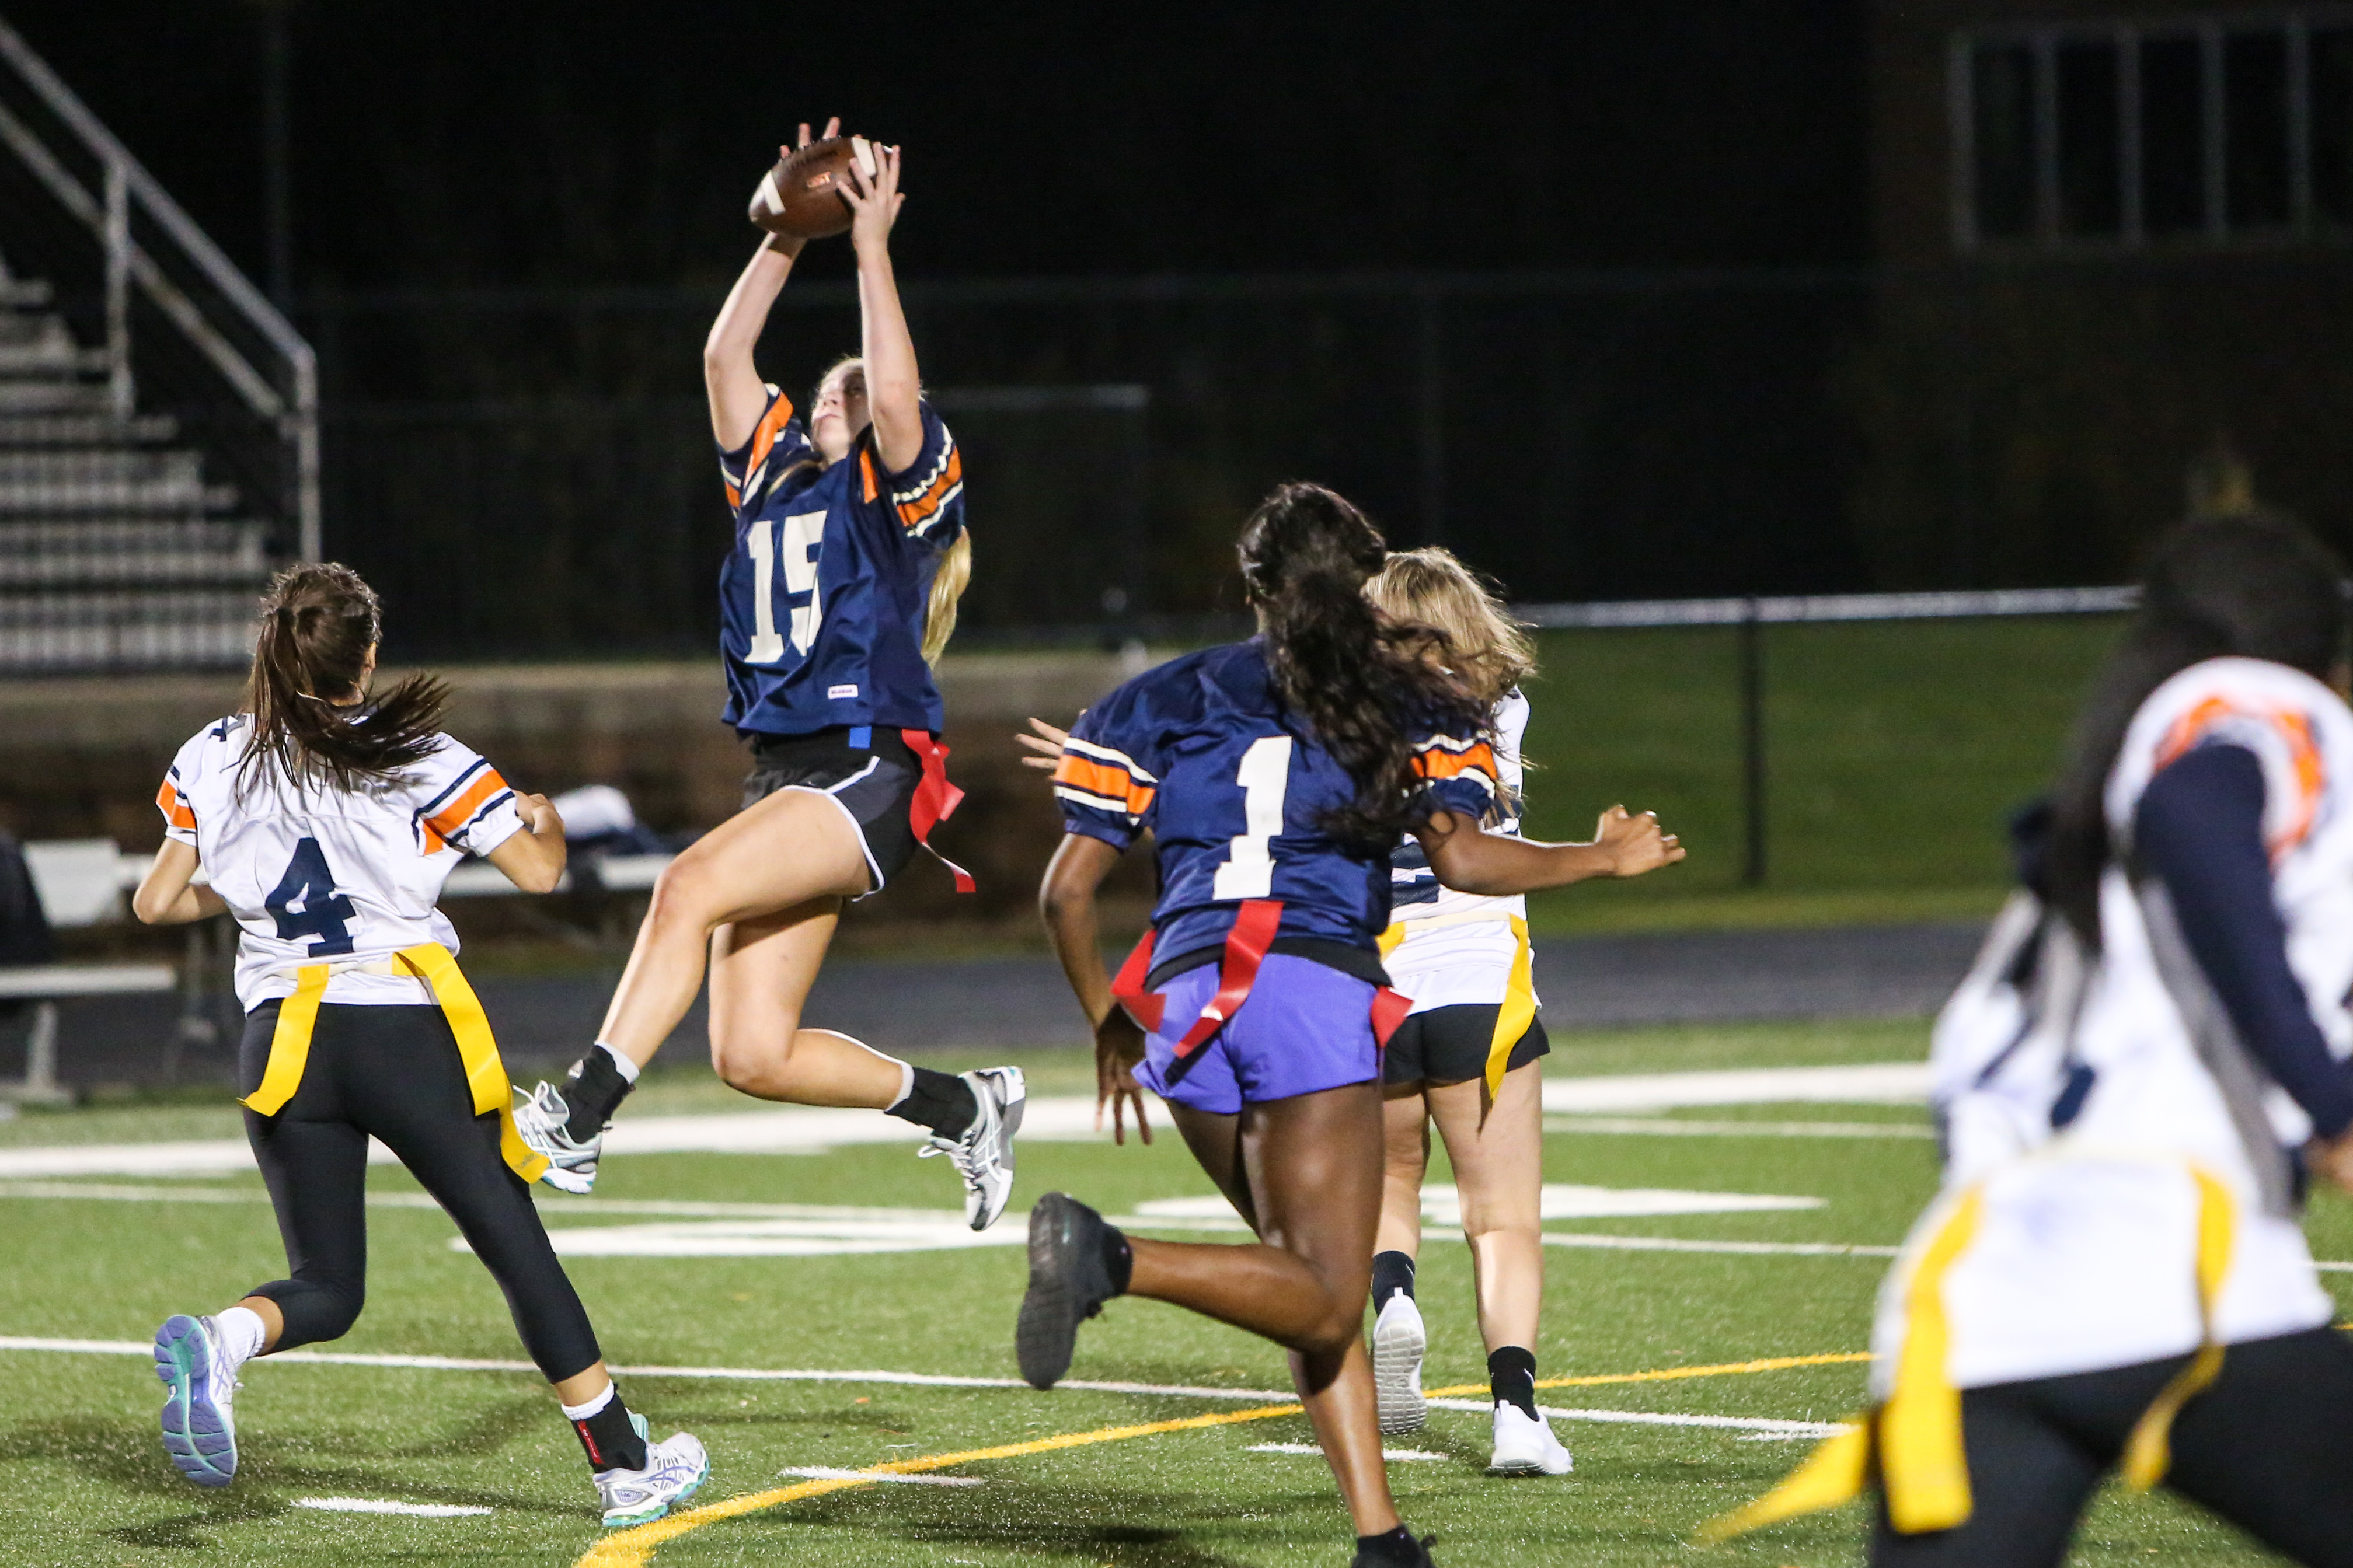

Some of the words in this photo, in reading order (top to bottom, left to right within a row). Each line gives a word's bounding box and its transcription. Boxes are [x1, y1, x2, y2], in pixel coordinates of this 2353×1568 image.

[744, 510, 827, 663] 15
[1212, 736, 1292, 900] 1
[264, 837, 357, 958] 4
